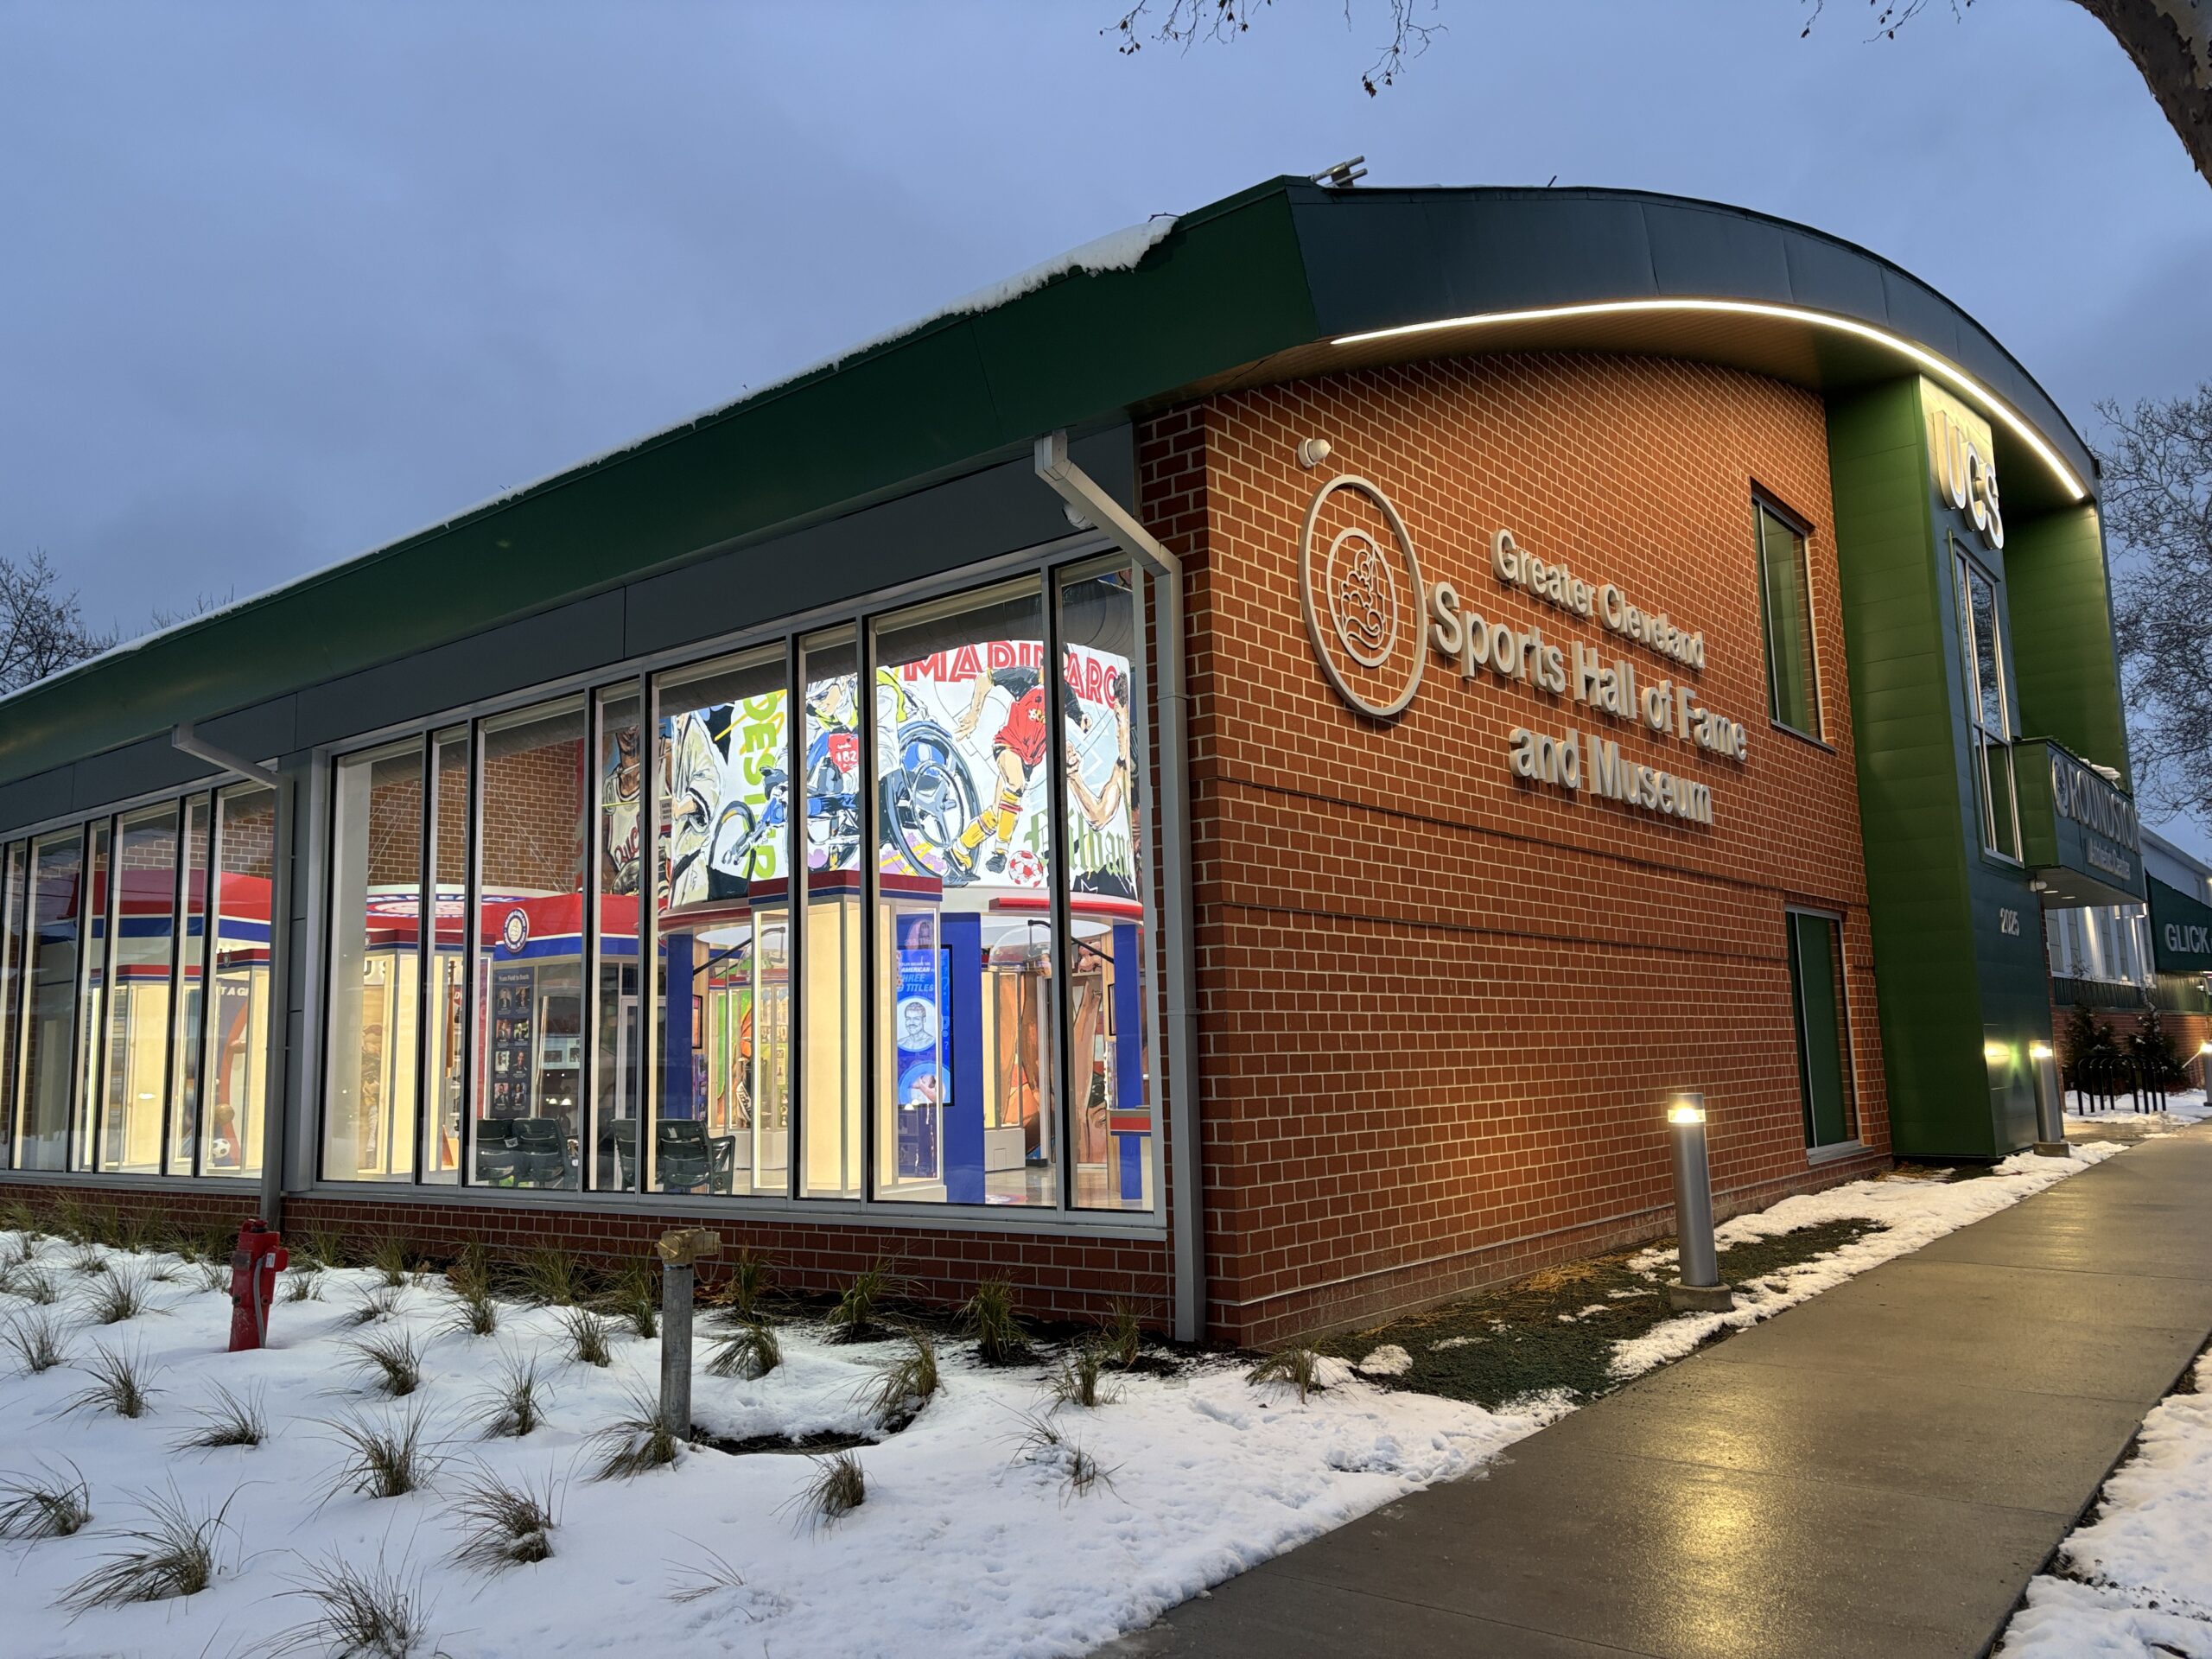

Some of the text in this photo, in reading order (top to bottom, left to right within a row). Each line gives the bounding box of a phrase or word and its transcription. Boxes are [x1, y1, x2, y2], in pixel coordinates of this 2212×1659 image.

[1933, 410, 2005, 550] UCS
[1491, 528, 1706, 671] Greater Cleveland
[1427, 581, 1748, 762] Sports Hall of Fame
[1509, 728, 1713, 825] and Museum
[2000, 907, 2019, 937] 2025
[2164, 923, 2211, 954] GLICK
[906, 983, 934, 992] TITLES
